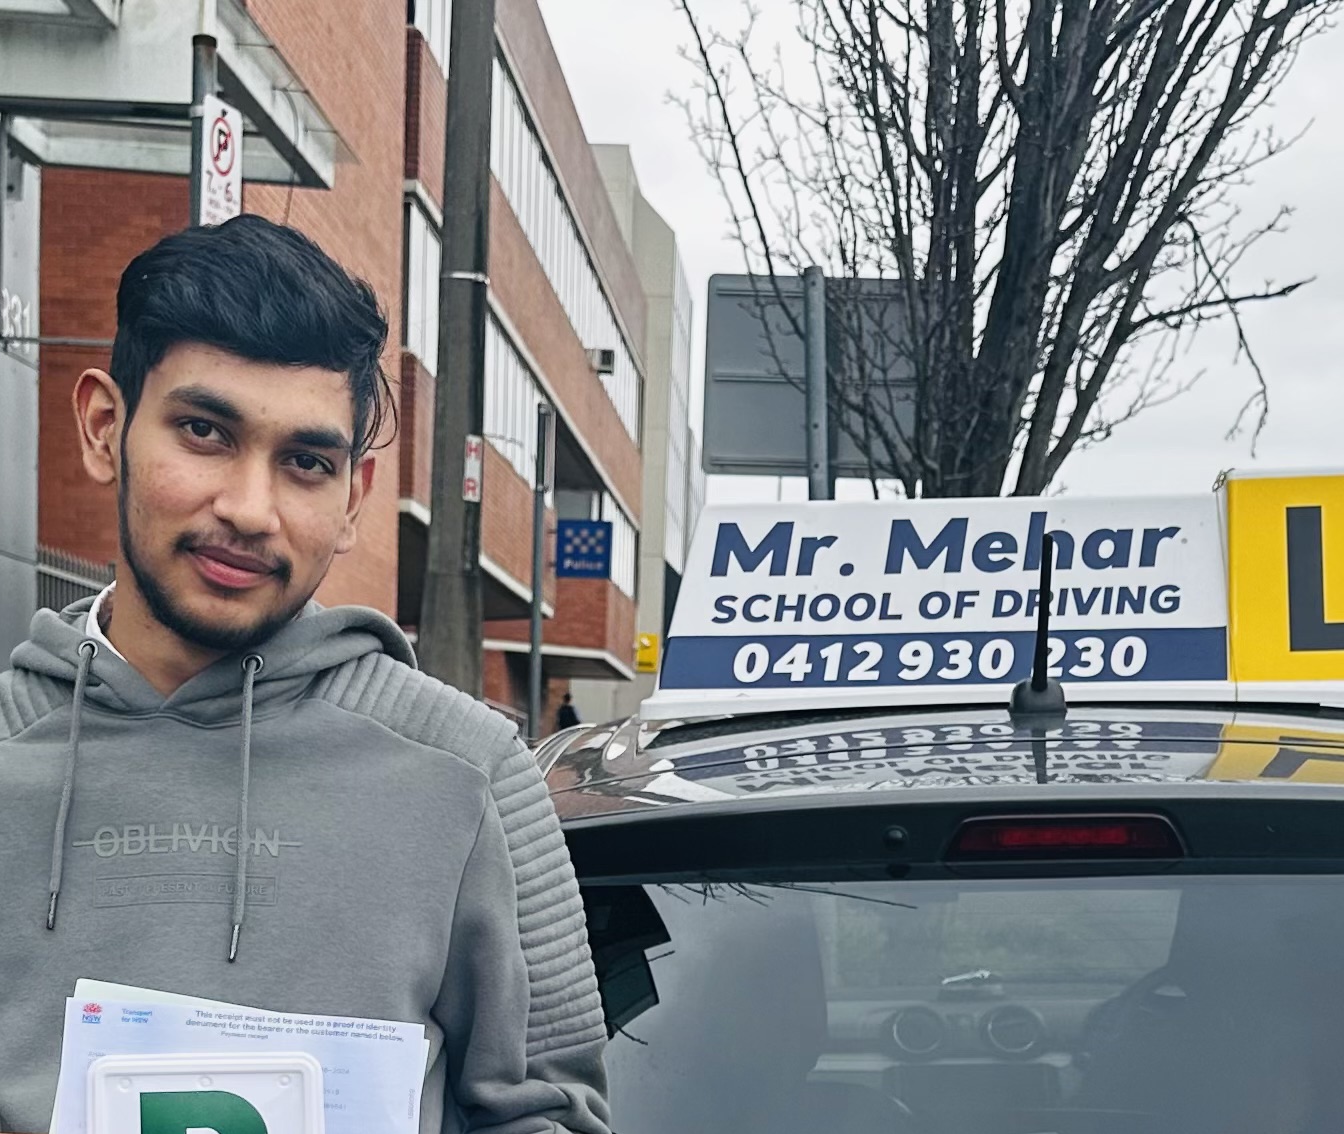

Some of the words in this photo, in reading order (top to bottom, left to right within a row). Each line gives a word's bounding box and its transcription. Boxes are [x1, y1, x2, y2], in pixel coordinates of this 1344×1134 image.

[710, 521, 855, 577] Mr.
[884, 511, 1183, 575] Mehar
[564, 558, 604, 571] Police
[712, 592, 903, 625] SCHOOL
[919, 590, 977, 621] OF
[993, 584, 1182, 619] DRIVING
[733, 640, 881, 683] 0412
[898, 637, 1016, 681] 930
[93, 822, 280, 858] OBLIVION
[217, 883, 268, 896] FUURE
[185, 1019, 227, 1029] document
[228, 1021, 241, 1030] for
[242, 1023, 256, 1031] the
[257, 1024, 284, 1033] bearer
[295, 1025, 309, 1034] the
[310, 1028, 348, 1037] customer
[350, 1030, 378, 1039] named
[195, 1010, 213, 1019] This
[214, 1011, 243, 1021] receipt
[244, 1013, 266, 1022] must
[267, 1015, 281, 1024] not
[282, 1016, 293, 1025] be
[294, 1017, 314, 1026] used
[332, 1020, 355, 1030] proof
